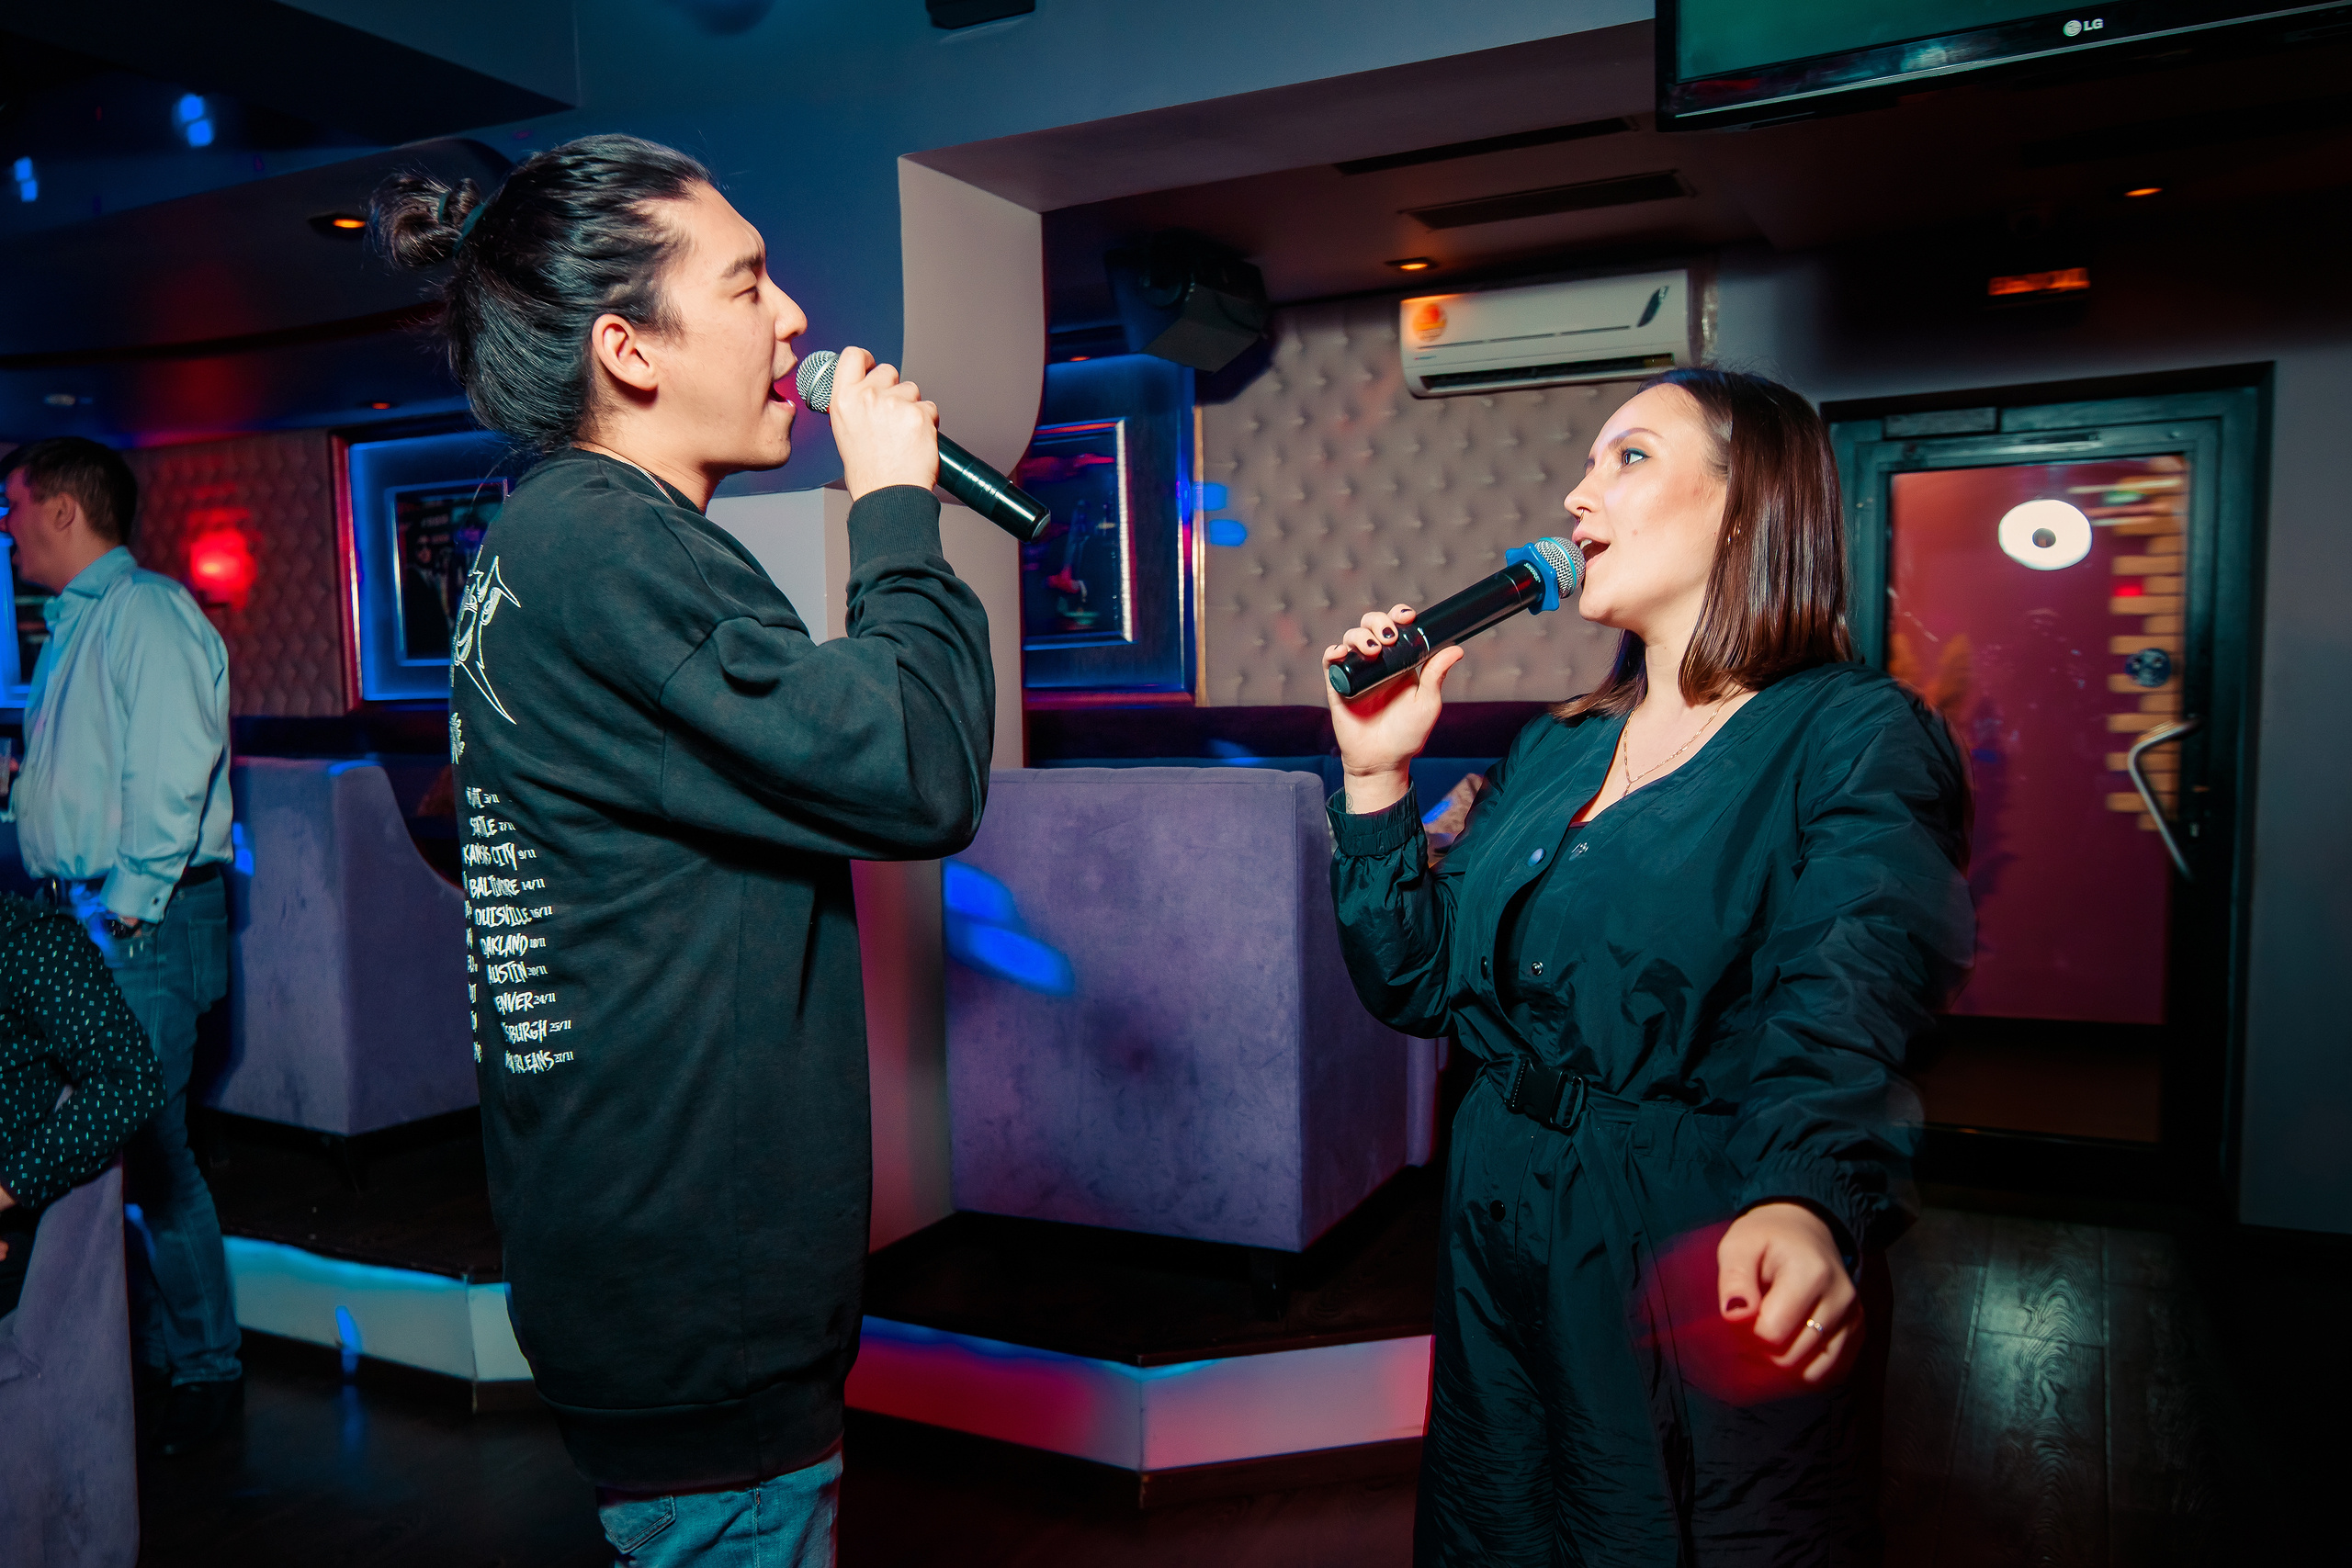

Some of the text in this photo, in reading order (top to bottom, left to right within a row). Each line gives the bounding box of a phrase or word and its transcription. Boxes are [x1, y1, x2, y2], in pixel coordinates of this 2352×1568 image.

[491, 841, 518, 871] CITY
[521, 878, 546, 891] 14/11
[533, 992, 556, 1005] 24/11
